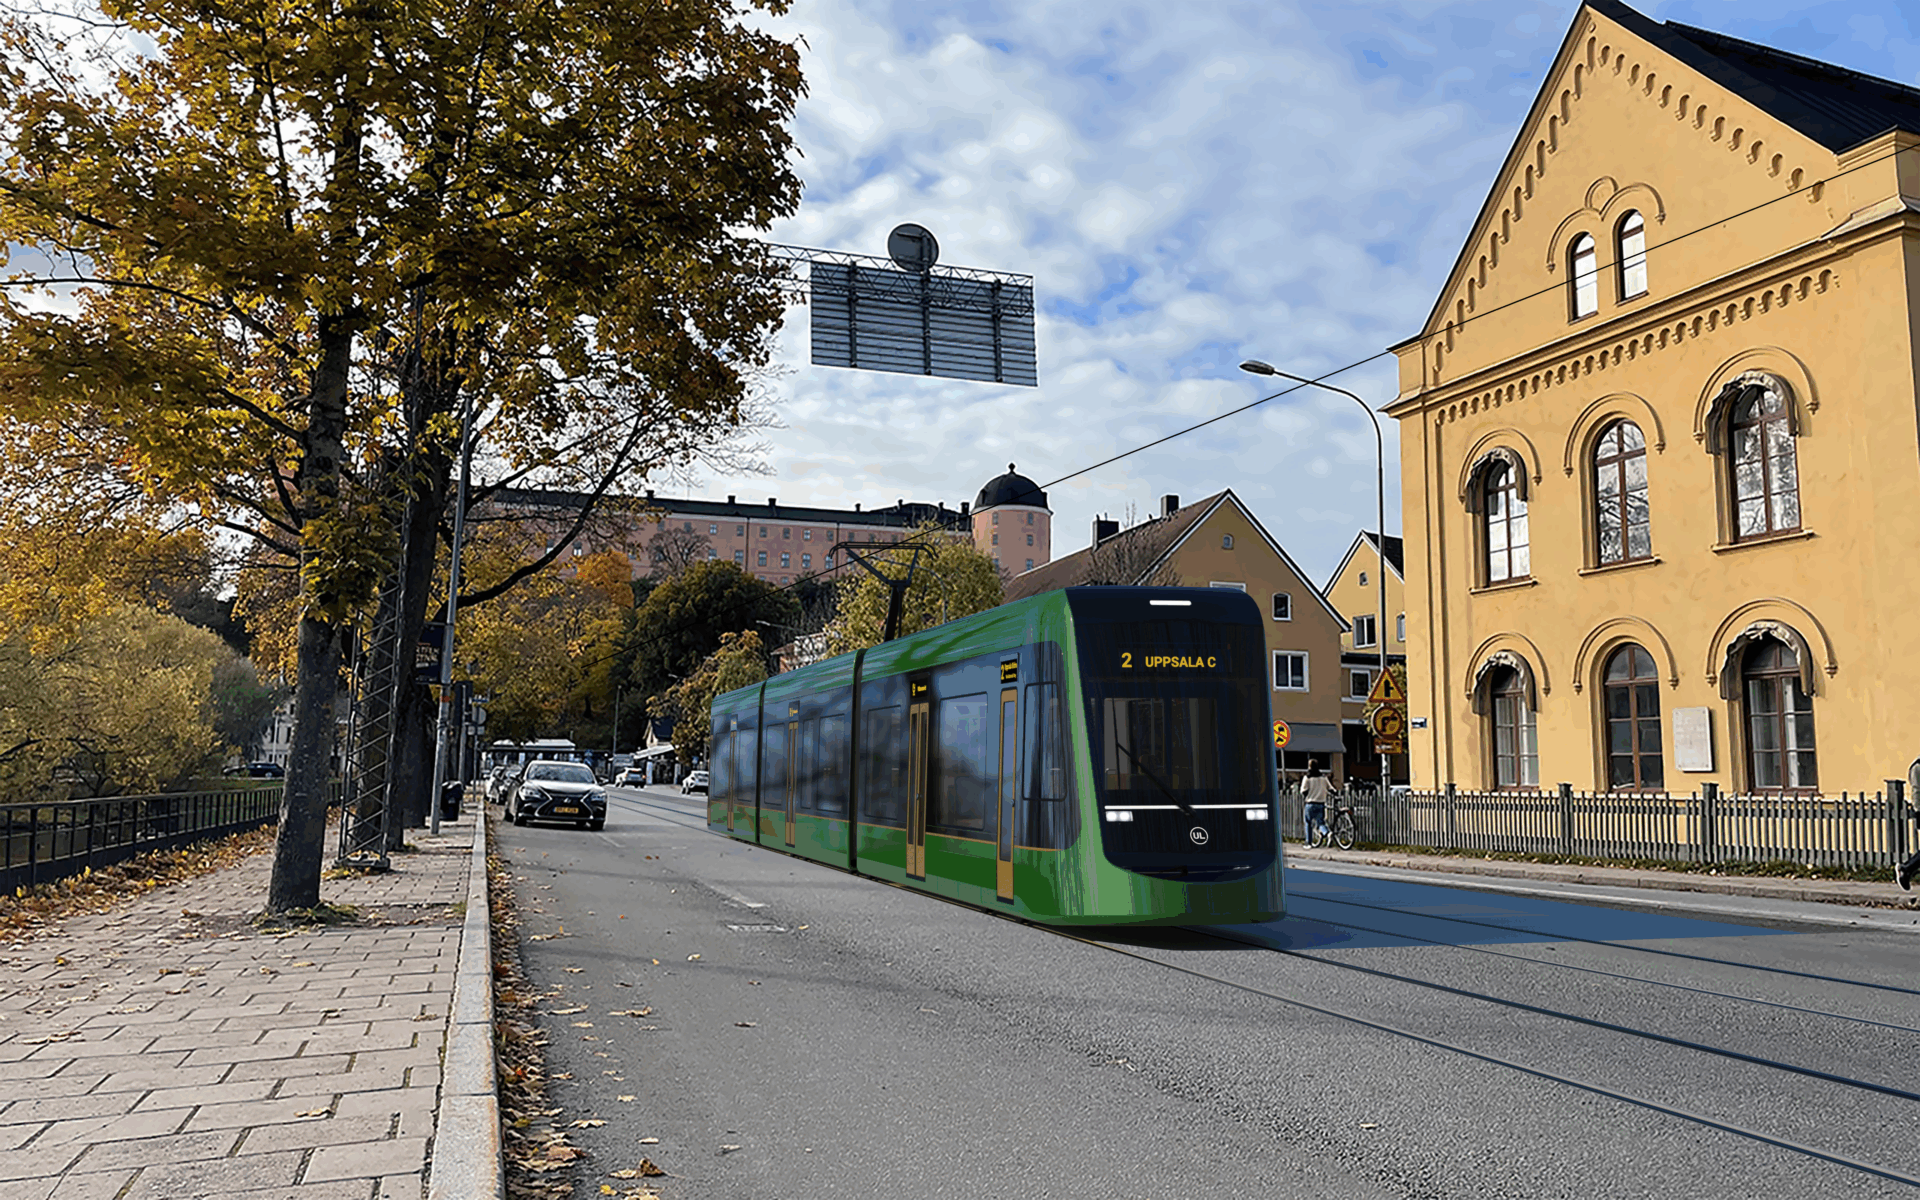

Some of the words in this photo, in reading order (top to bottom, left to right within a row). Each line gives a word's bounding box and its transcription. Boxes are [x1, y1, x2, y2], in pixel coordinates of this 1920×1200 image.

[1121, 652, 1133, 668] 2
[1145, 656, 1205, 668] UPPSALA
[1207, 656, 1217, 668] C
[1192, 831, 1206, 840] UL
